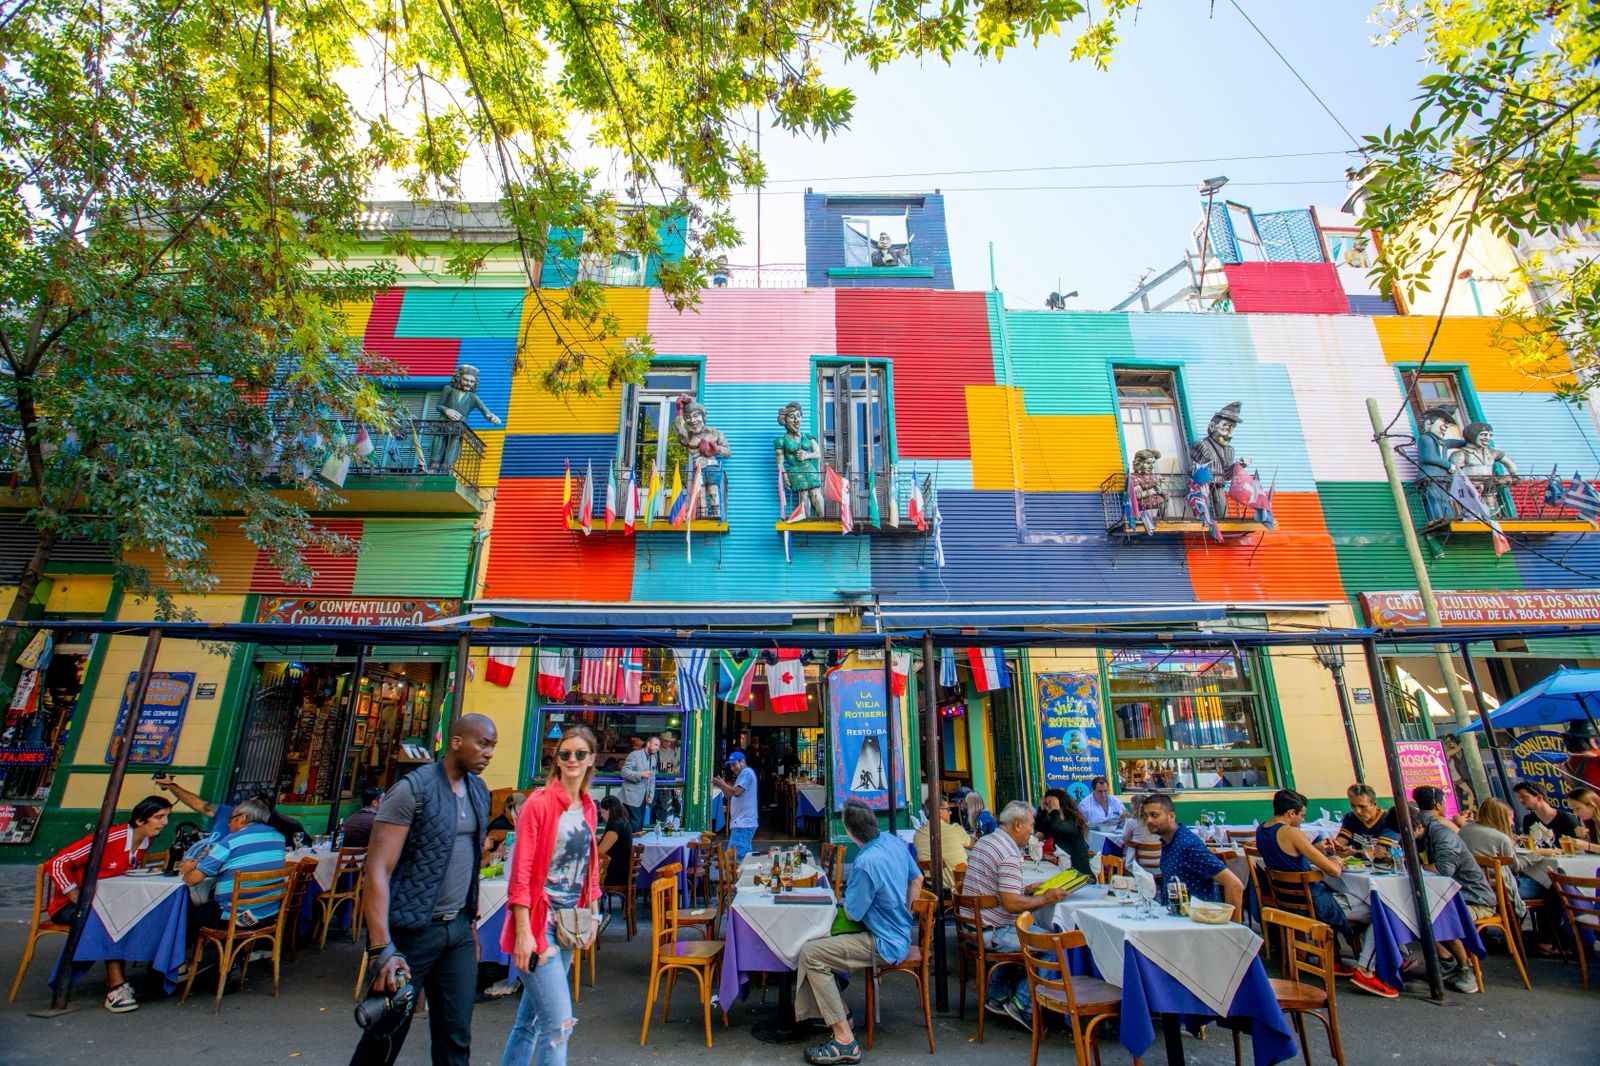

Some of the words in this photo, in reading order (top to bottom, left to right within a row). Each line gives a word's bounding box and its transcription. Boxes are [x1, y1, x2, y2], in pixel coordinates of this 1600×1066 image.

[319, 600, 401, 614] CONVENTILLO
[1385, 594, 1438, 610] CENT
[1441, 595, 1510, 610] CULTURAL
[1535, 594, 1566, 609] LOS
[1439, 609, 1483, 620] EPUBLICA
[1487, 609, 1501, 620] DE
[1503, 609, 1516, 620] LA
[1550, 608, 1599, 620] CAMINITO
[860, 691, 872, 699] LA
[1053, 702, 1088, 715] VIEJA
[1047, 717, 1096, 728] ROTISERIA
[1049, 755, 1072, 763] Pastas
[1075, 755, 1100, 763] Caseras
[1062, 764, 1092, 772] Mariscos
[1047, 773, 1070, 781] Carnes
